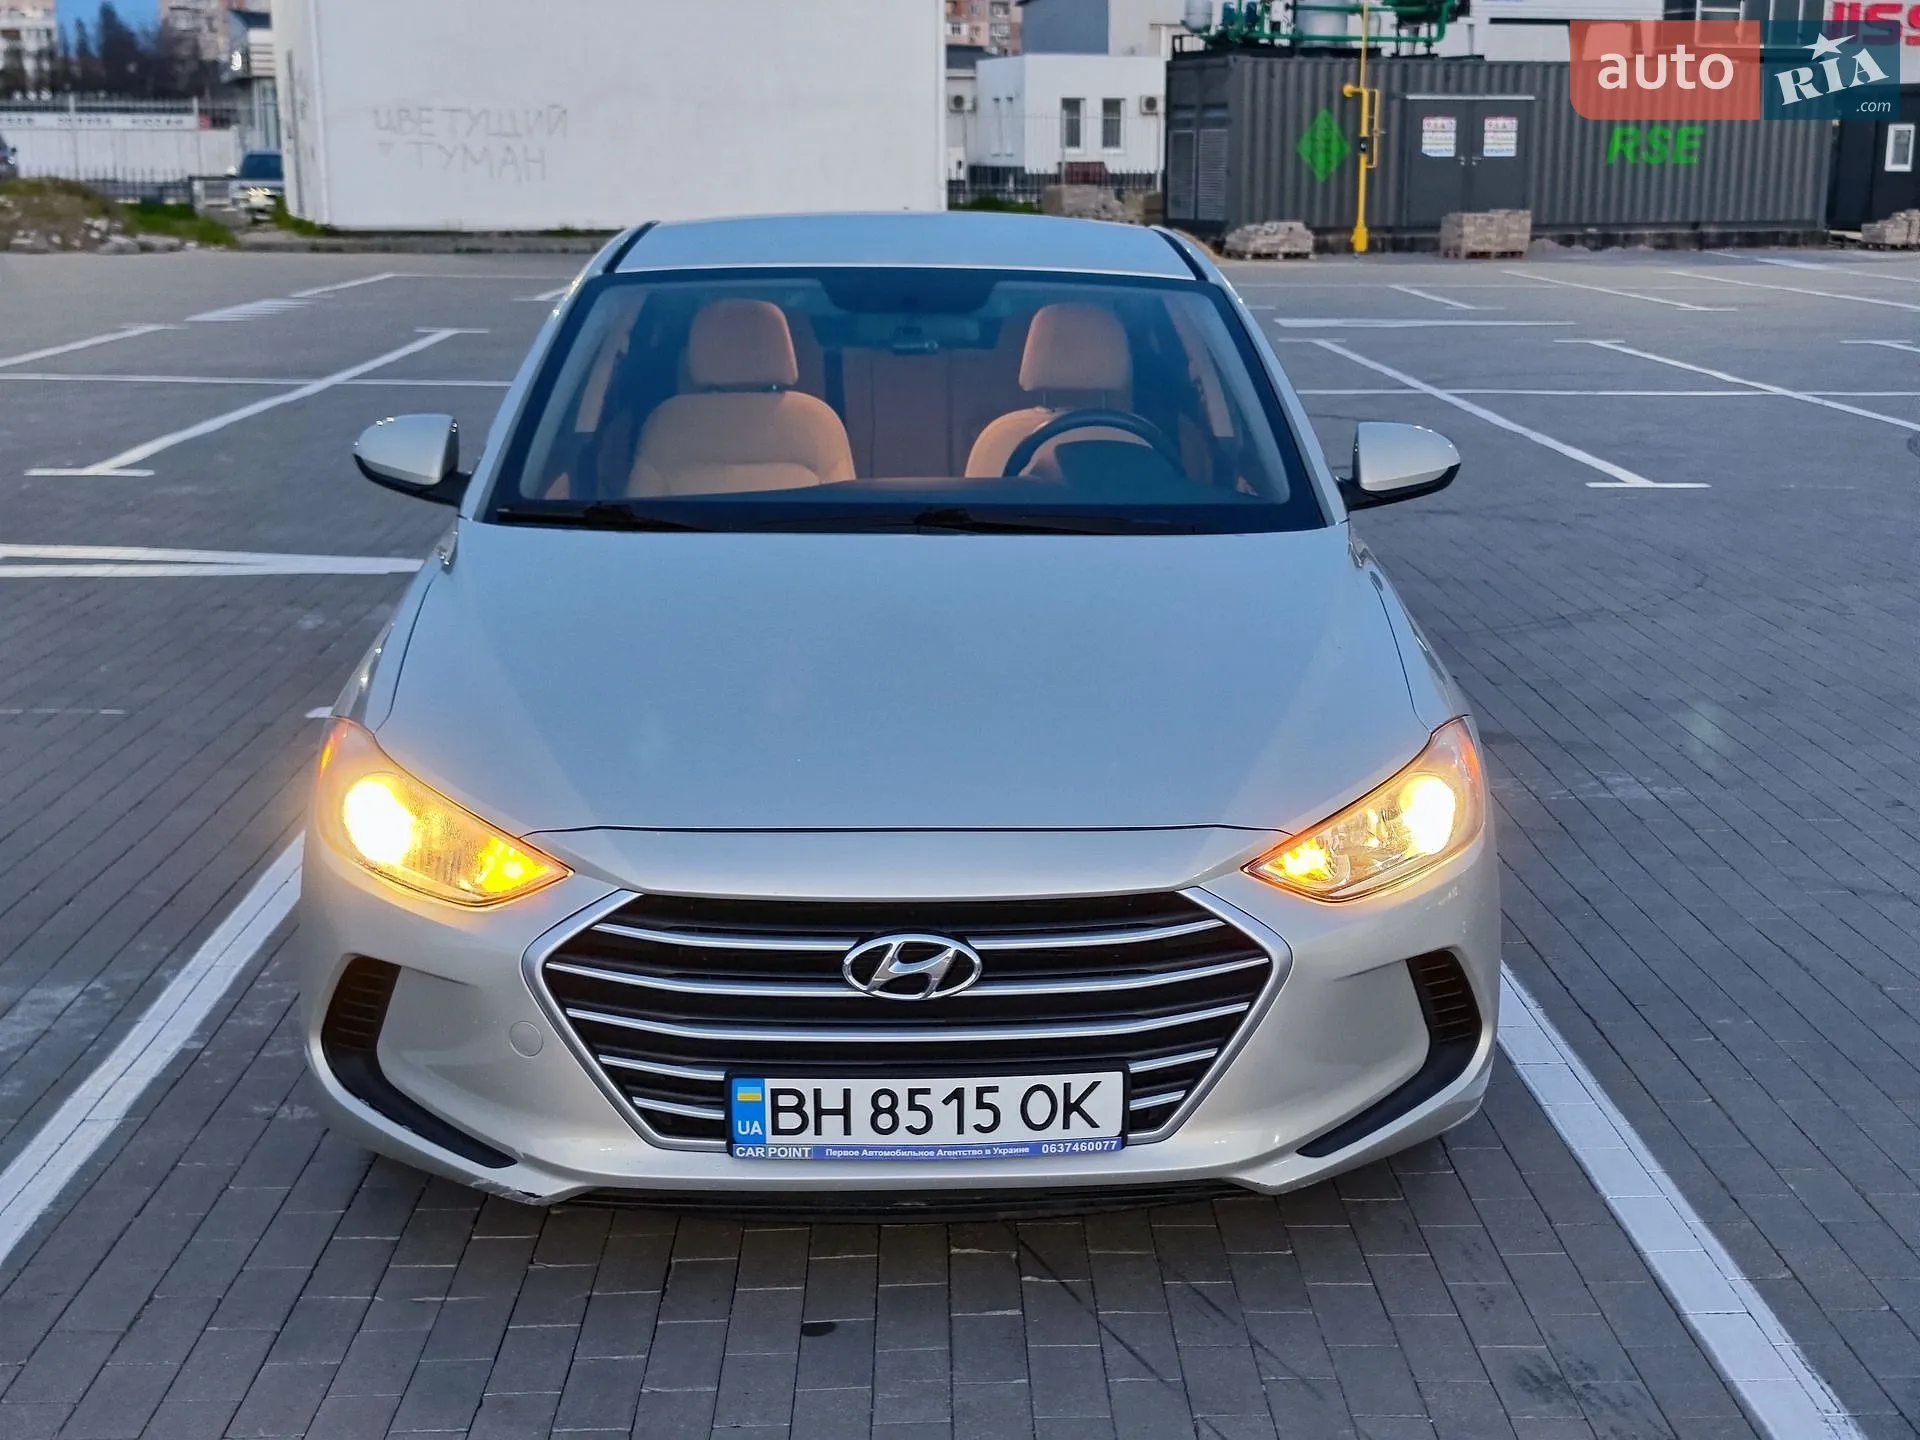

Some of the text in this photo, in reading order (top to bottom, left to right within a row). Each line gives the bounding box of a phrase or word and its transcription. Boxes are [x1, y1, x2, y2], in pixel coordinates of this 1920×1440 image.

[1606, 125, 1704, 164] RSE
[770, 1081, 1102, 1136] BH 8515 OK
[737, 1120, 763, 1135] UA
[736, 1147, 812, 1158] CAR POINT
[825, 1149, 859, 1157] Первое
[861, 1148, 934, 1157] Автомобильное
[936, 1147, 983, 1157] Агентство
[993, 1147, 1030, 1156] Украине
[1041, 1140, 1118, 1154] 0637460077
